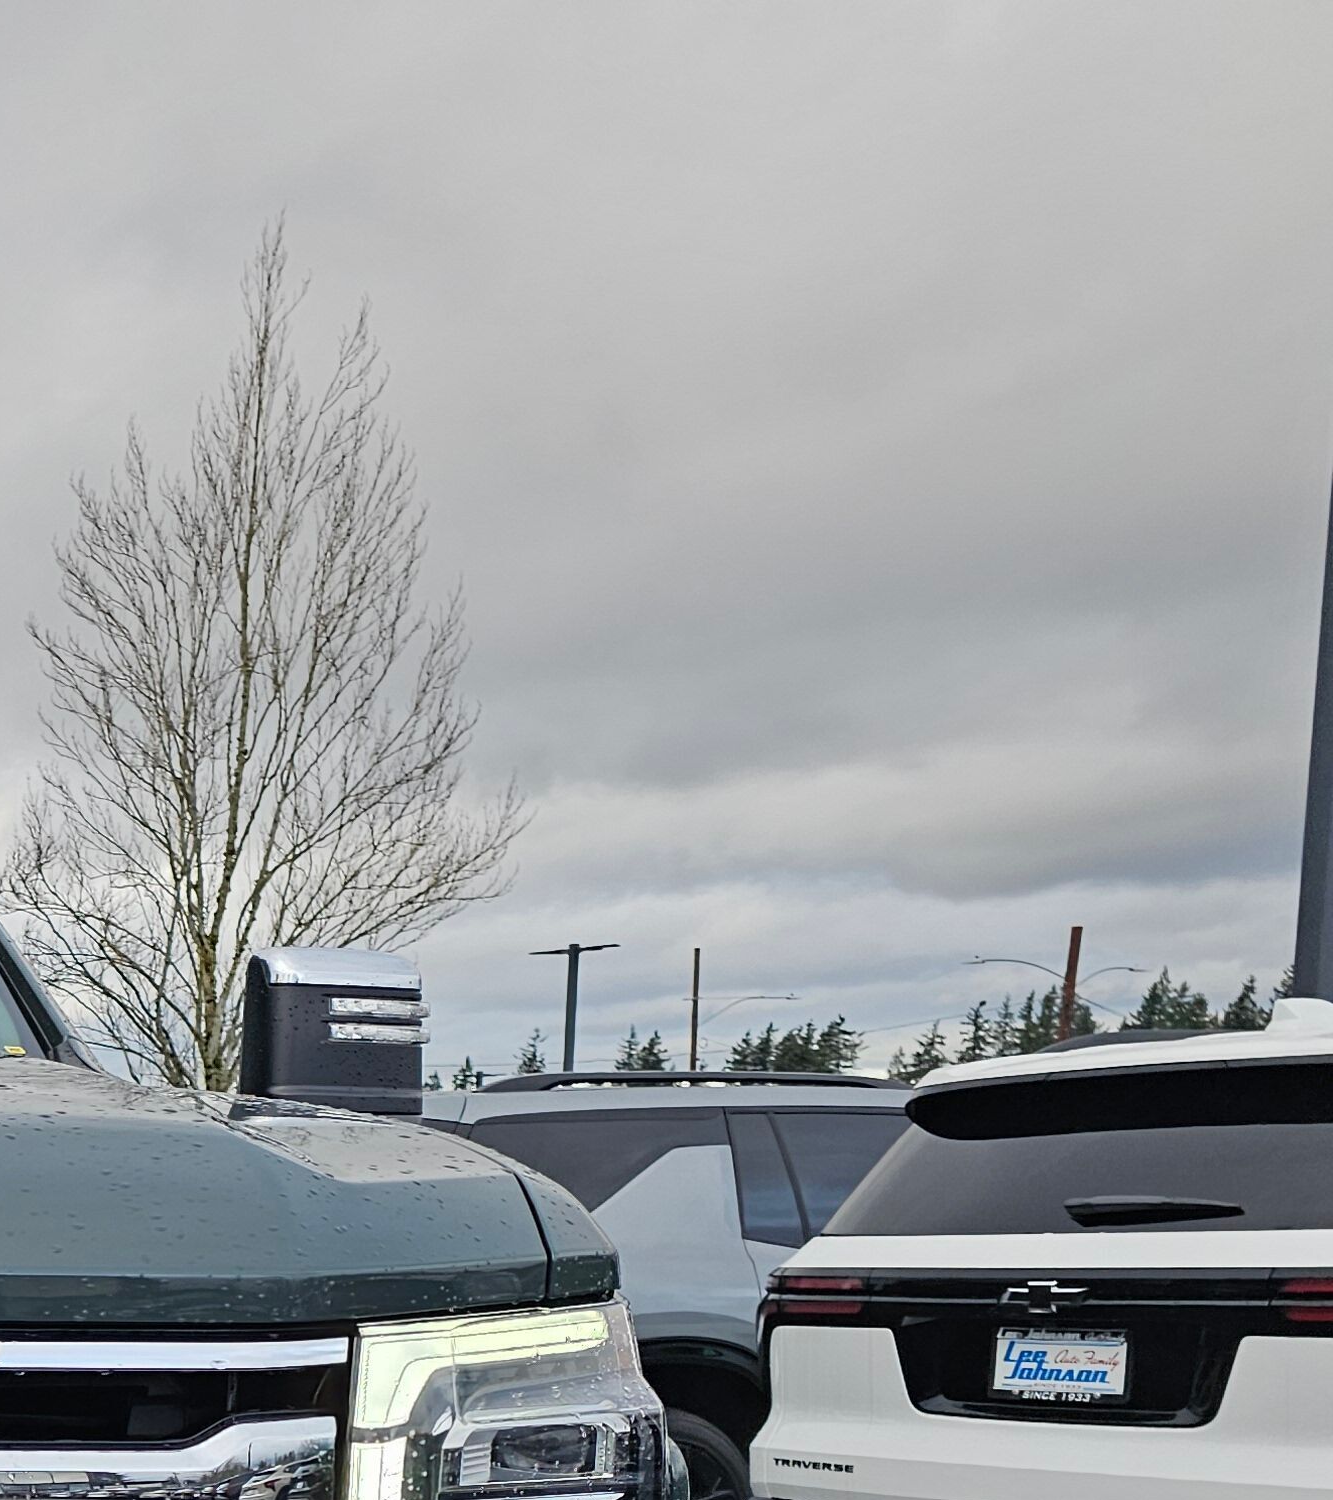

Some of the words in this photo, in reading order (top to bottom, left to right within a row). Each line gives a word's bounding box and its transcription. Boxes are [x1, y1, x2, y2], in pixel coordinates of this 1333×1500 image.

[1004, 1341, 1049, 1363] Lee
[1054, 1349, 1079, 1364] Auto
[1083, 1350, 1119, 1371] Family
[1004, 1360, 1109, 1384] Johnson
[1022, 1390, 1057, 1400] SINCE
[1061, 1392, 1091, 1403] 1933
[773, 1458, 854, 1473] TRAVERSE
